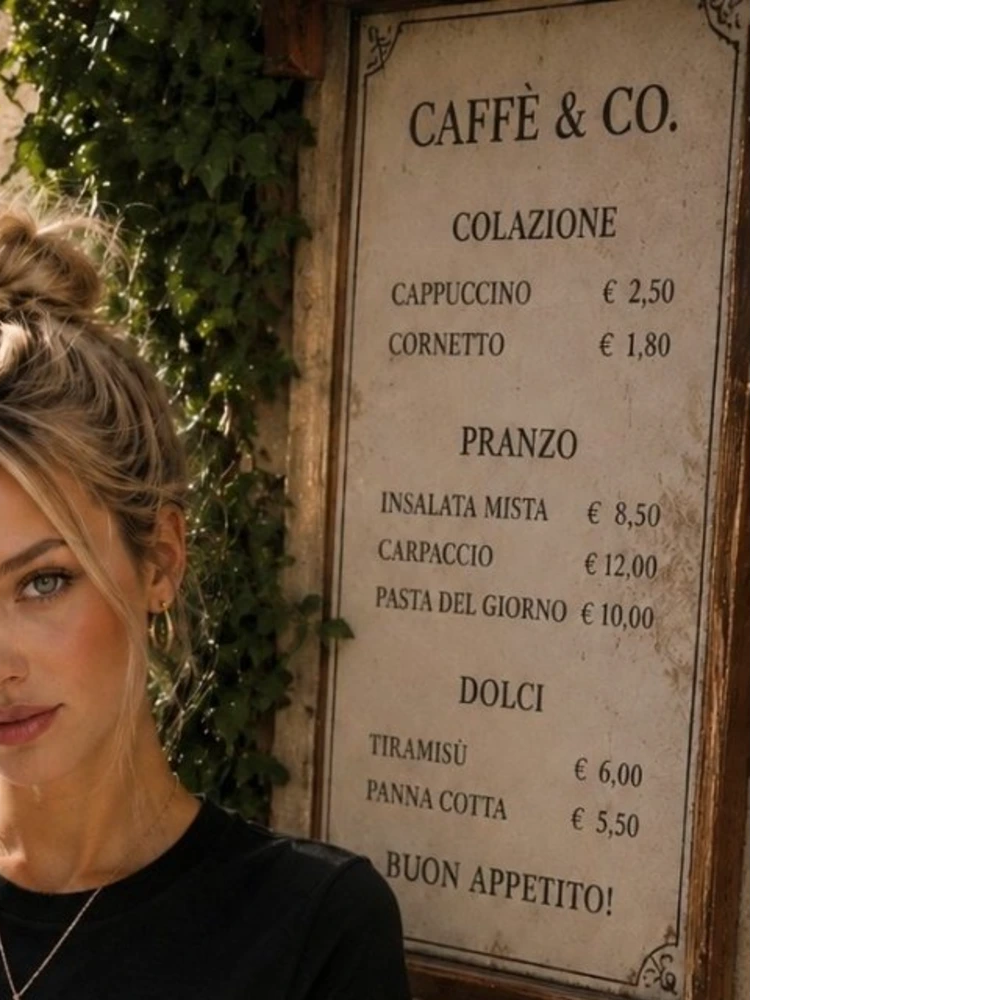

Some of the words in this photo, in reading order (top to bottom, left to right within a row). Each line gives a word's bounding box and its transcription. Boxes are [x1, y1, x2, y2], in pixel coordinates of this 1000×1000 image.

[408, 82, 540, 148] CAFFÈ
[555, 90, 587, 140] &
[602, 83, 678, 136] CO.
[452, 206, 618, 242] COLAZIONE
[391, 279, 532, 307] CAPPUCCINO
[602, 278, 618, 304] €
[628, 278, 675, 309] 2,50
[388, 331, 505, 358] CORNETTO
[599, 331, 615, 358] €
[627, 331, 671, 361] 1,80
[459, 425, 578, 460] PRANZO
[380, 490, 478, 519] INSALATA
[484, 495, 549, 522] MISTA
[586, 500, 602, 525] €
[614, 501, 662, 530] 8,50
[377, 538, 494, 567] CARPACCIO
[604, 552, 658, 581] 12,00
[375, 585, 433, 613] PASTA
[438, 590, 477, 616] DEL
[481, 594, 568, 623] GIORNO
[580, 601, 595, 626] €
[601, 602, 655, 631] 10,00
[459, 675, 544, 713] DOLCI
[368, 732, 468, 766] TIRAMISÙ
[574, 757, 588, 782] €
[598, 758, 643, 788] 6,00
[365, 778, 434, 811] PANNA
[438, 789, 507, 821] COTTA
[570, 806, 585, 831] €
[595, 809, 640, 839] 5,50
[386, 850, 461, 890] BUON
[468, 865, 613, 917] APPETITO!
